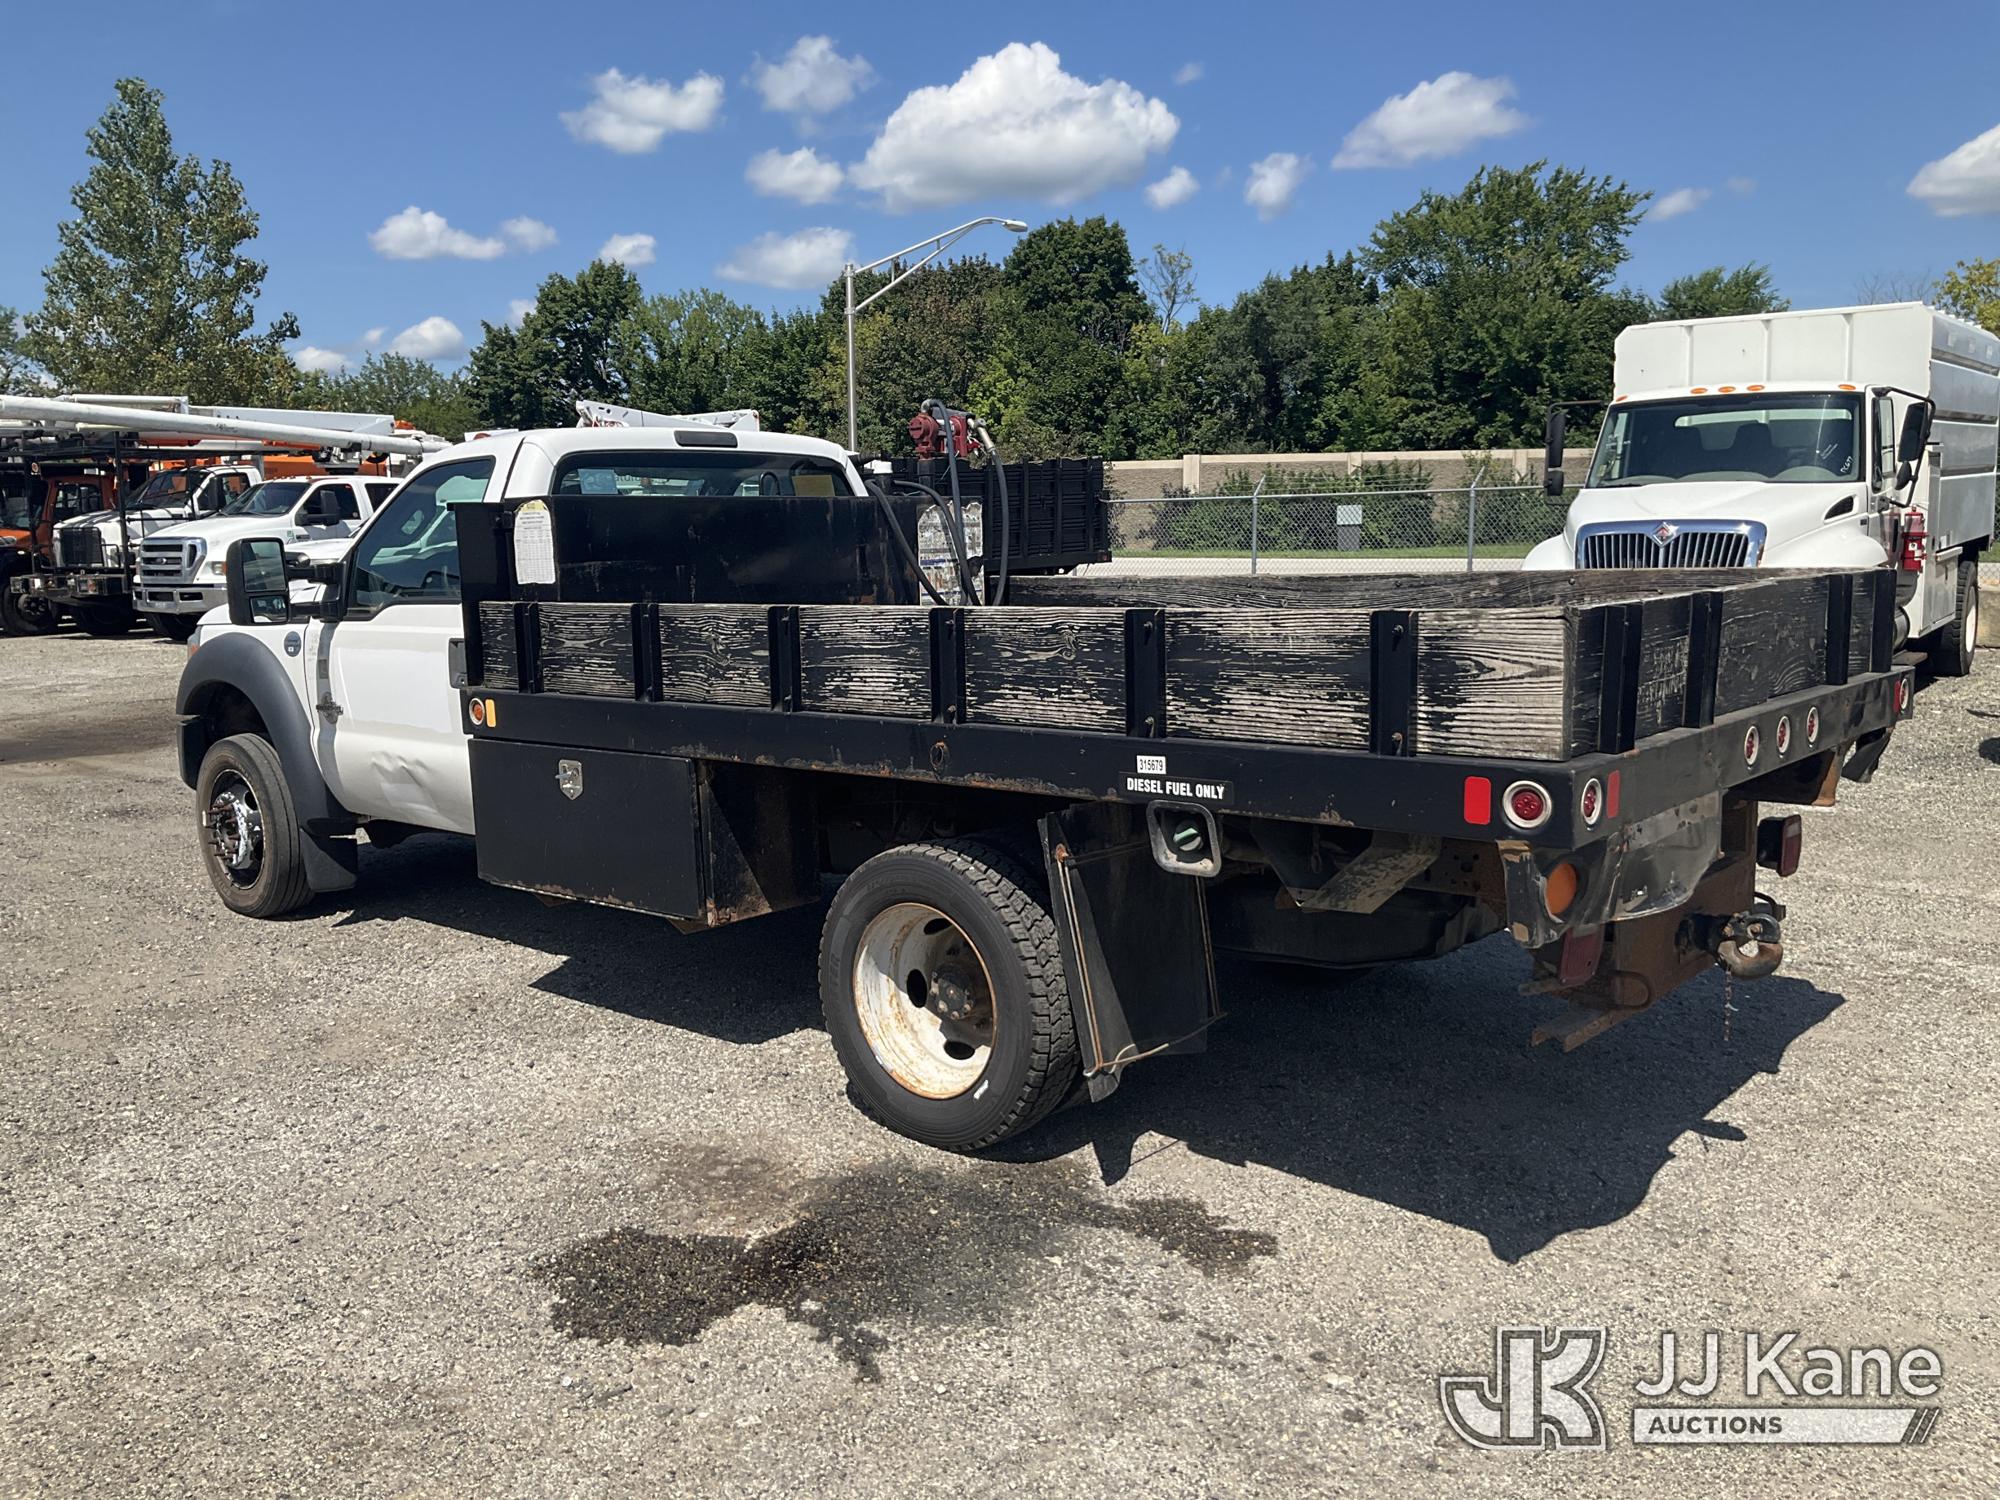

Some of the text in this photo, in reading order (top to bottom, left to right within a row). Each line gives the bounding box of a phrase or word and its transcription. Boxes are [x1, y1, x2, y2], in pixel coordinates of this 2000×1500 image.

[1139, 758, 1164, 771] 315679
[1126, 777, 1225, 800] DIESEL FUEL ONLY
